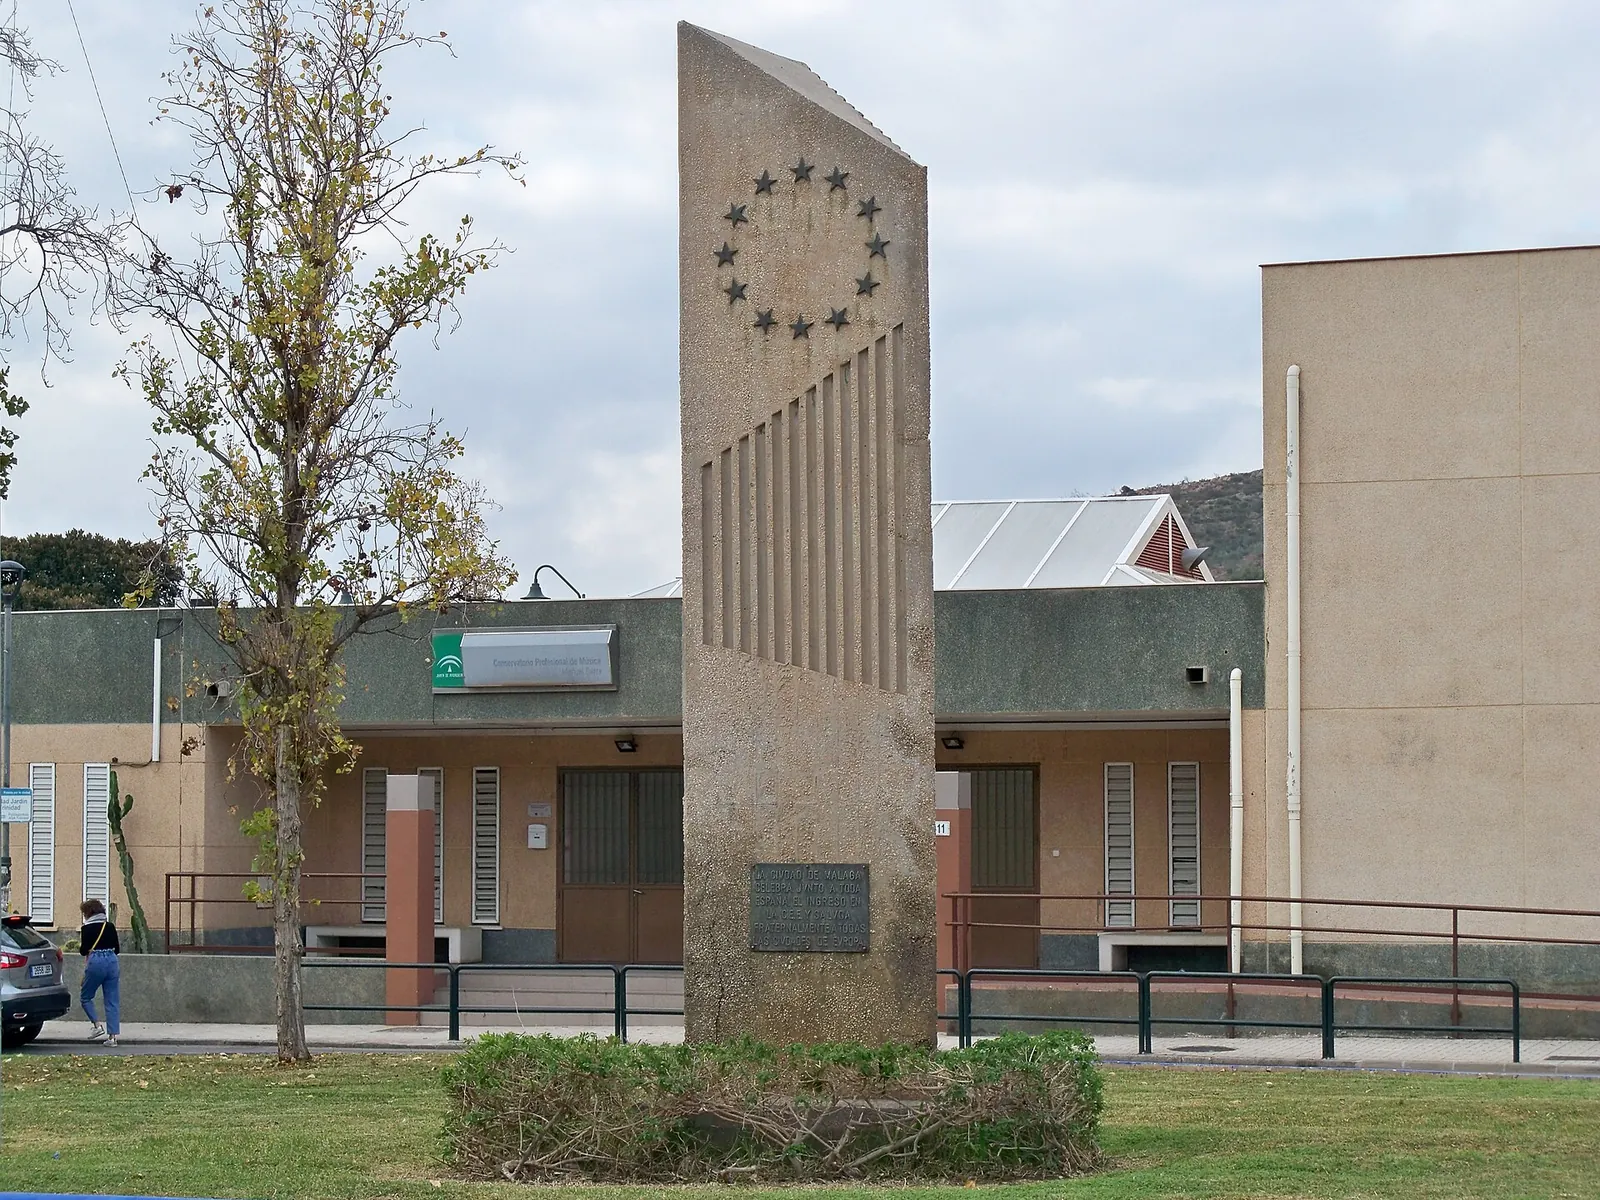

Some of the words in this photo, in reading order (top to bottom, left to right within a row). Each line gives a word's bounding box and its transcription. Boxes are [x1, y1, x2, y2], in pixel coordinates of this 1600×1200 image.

[936, 823, 945, 834] 11
[808, 870, 819, 880] DE
[829, 884, 836, 893] A
[839, 883, 861, 893] TODA
[793, 896, 803, 906] EL
[806, 896, 847, 907] INGRESO
[850, 896, 861, 907] EN
[804, 910, 812, 920] Y
[838, 923, 867, 934] TODAS
[752, 936, 769, 946] LAS
[817, 936, 829, 947] DE
